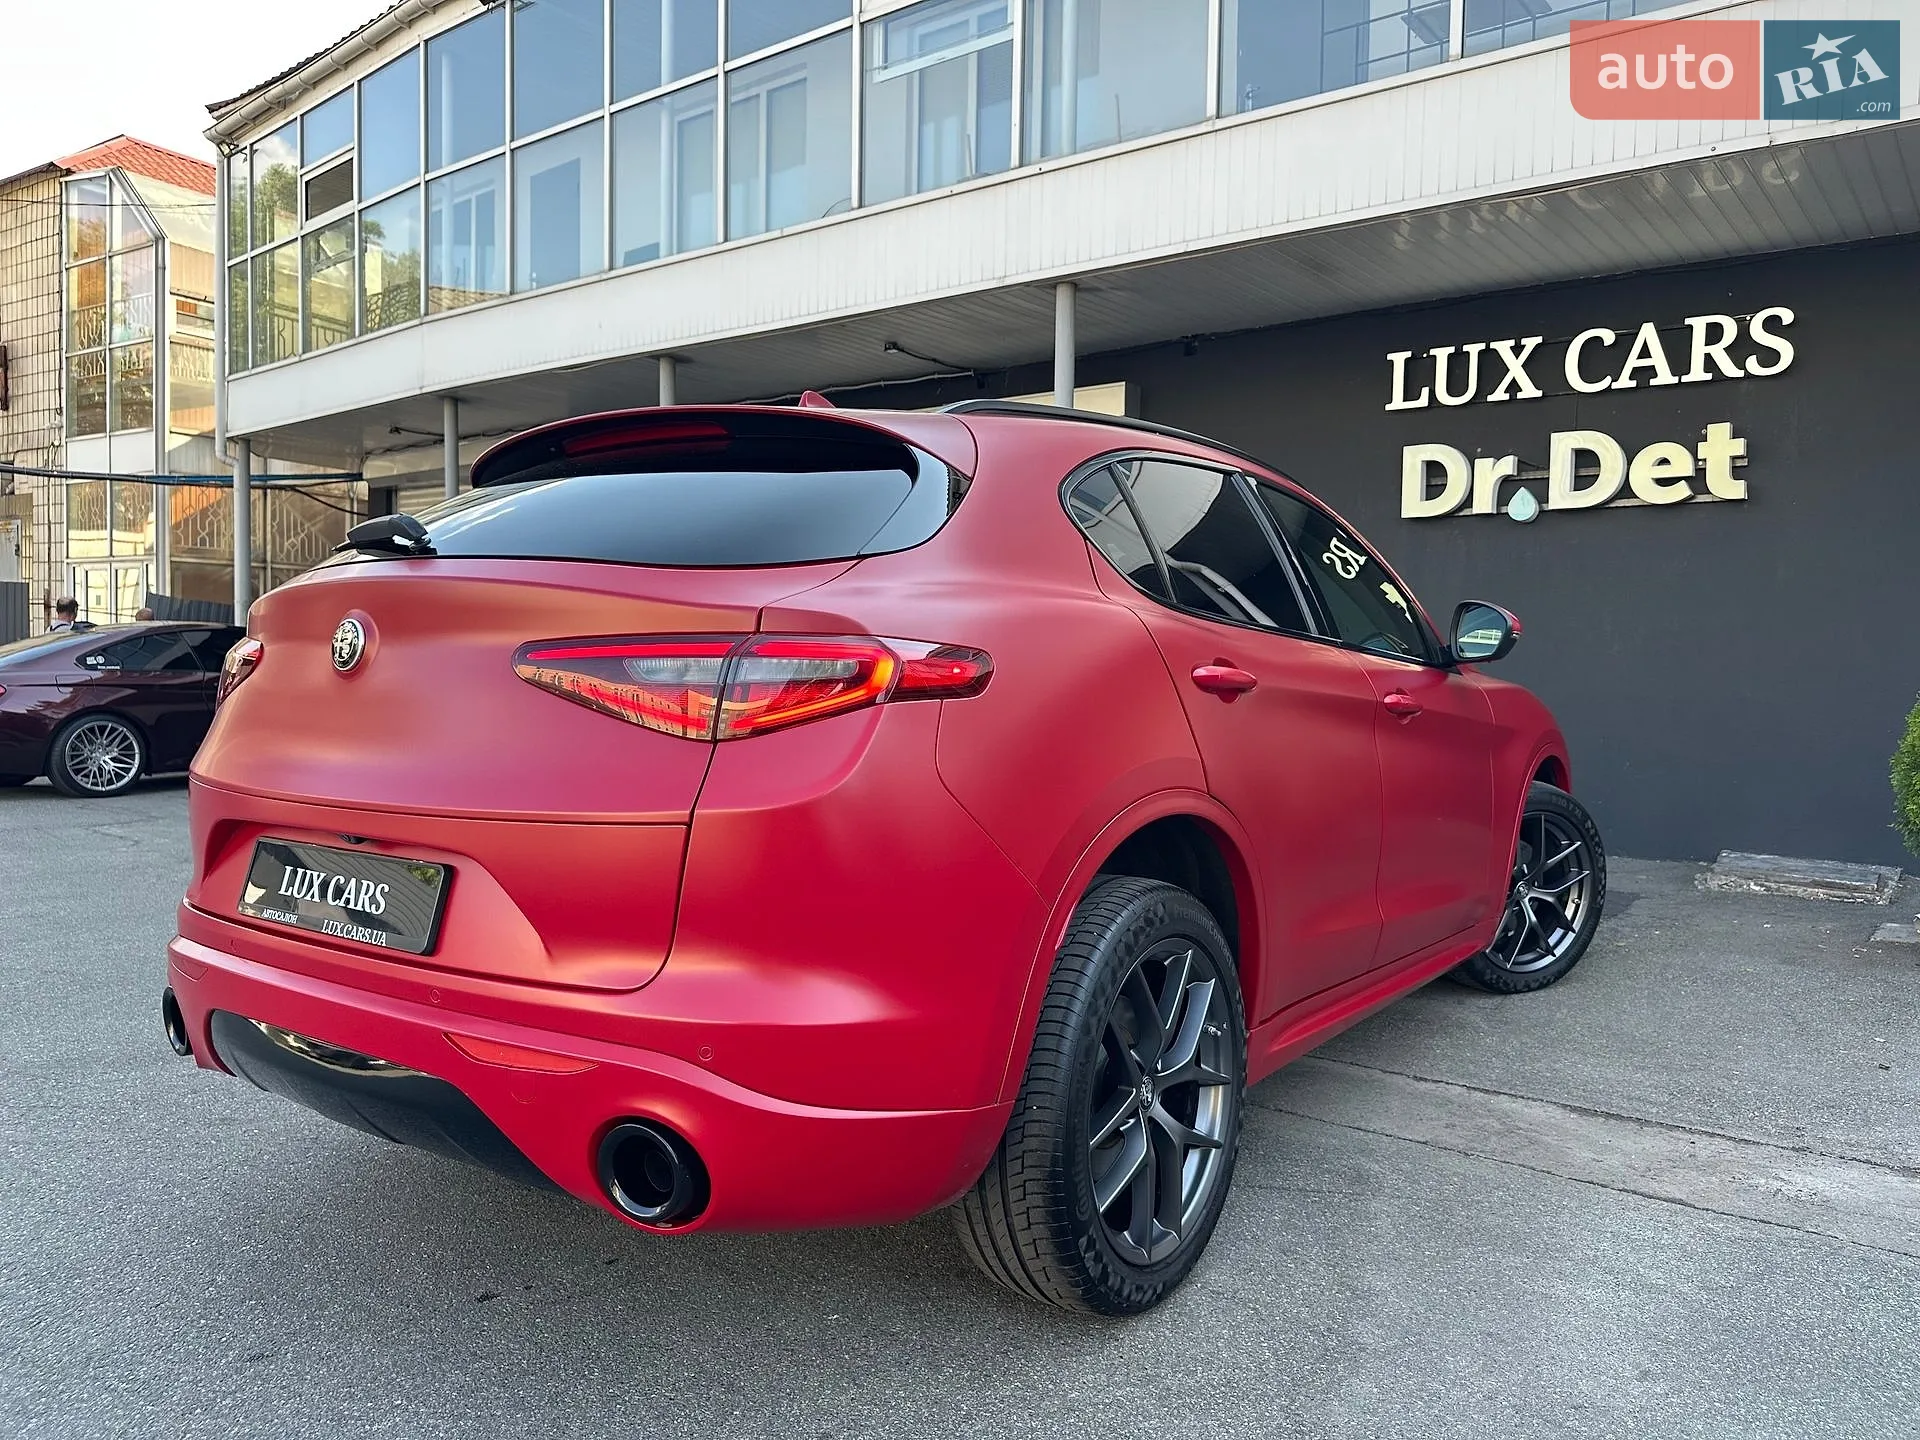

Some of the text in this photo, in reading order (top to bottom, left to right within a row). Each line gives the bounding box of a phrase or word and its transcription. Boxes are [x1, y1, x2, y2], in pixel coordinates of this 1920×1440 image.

[1384, 306, 1796, 411] LUX CARS
[278, 865, 390, 915] LUX CARS
[261, 908, 298, 924] АВТОСАЛОН
